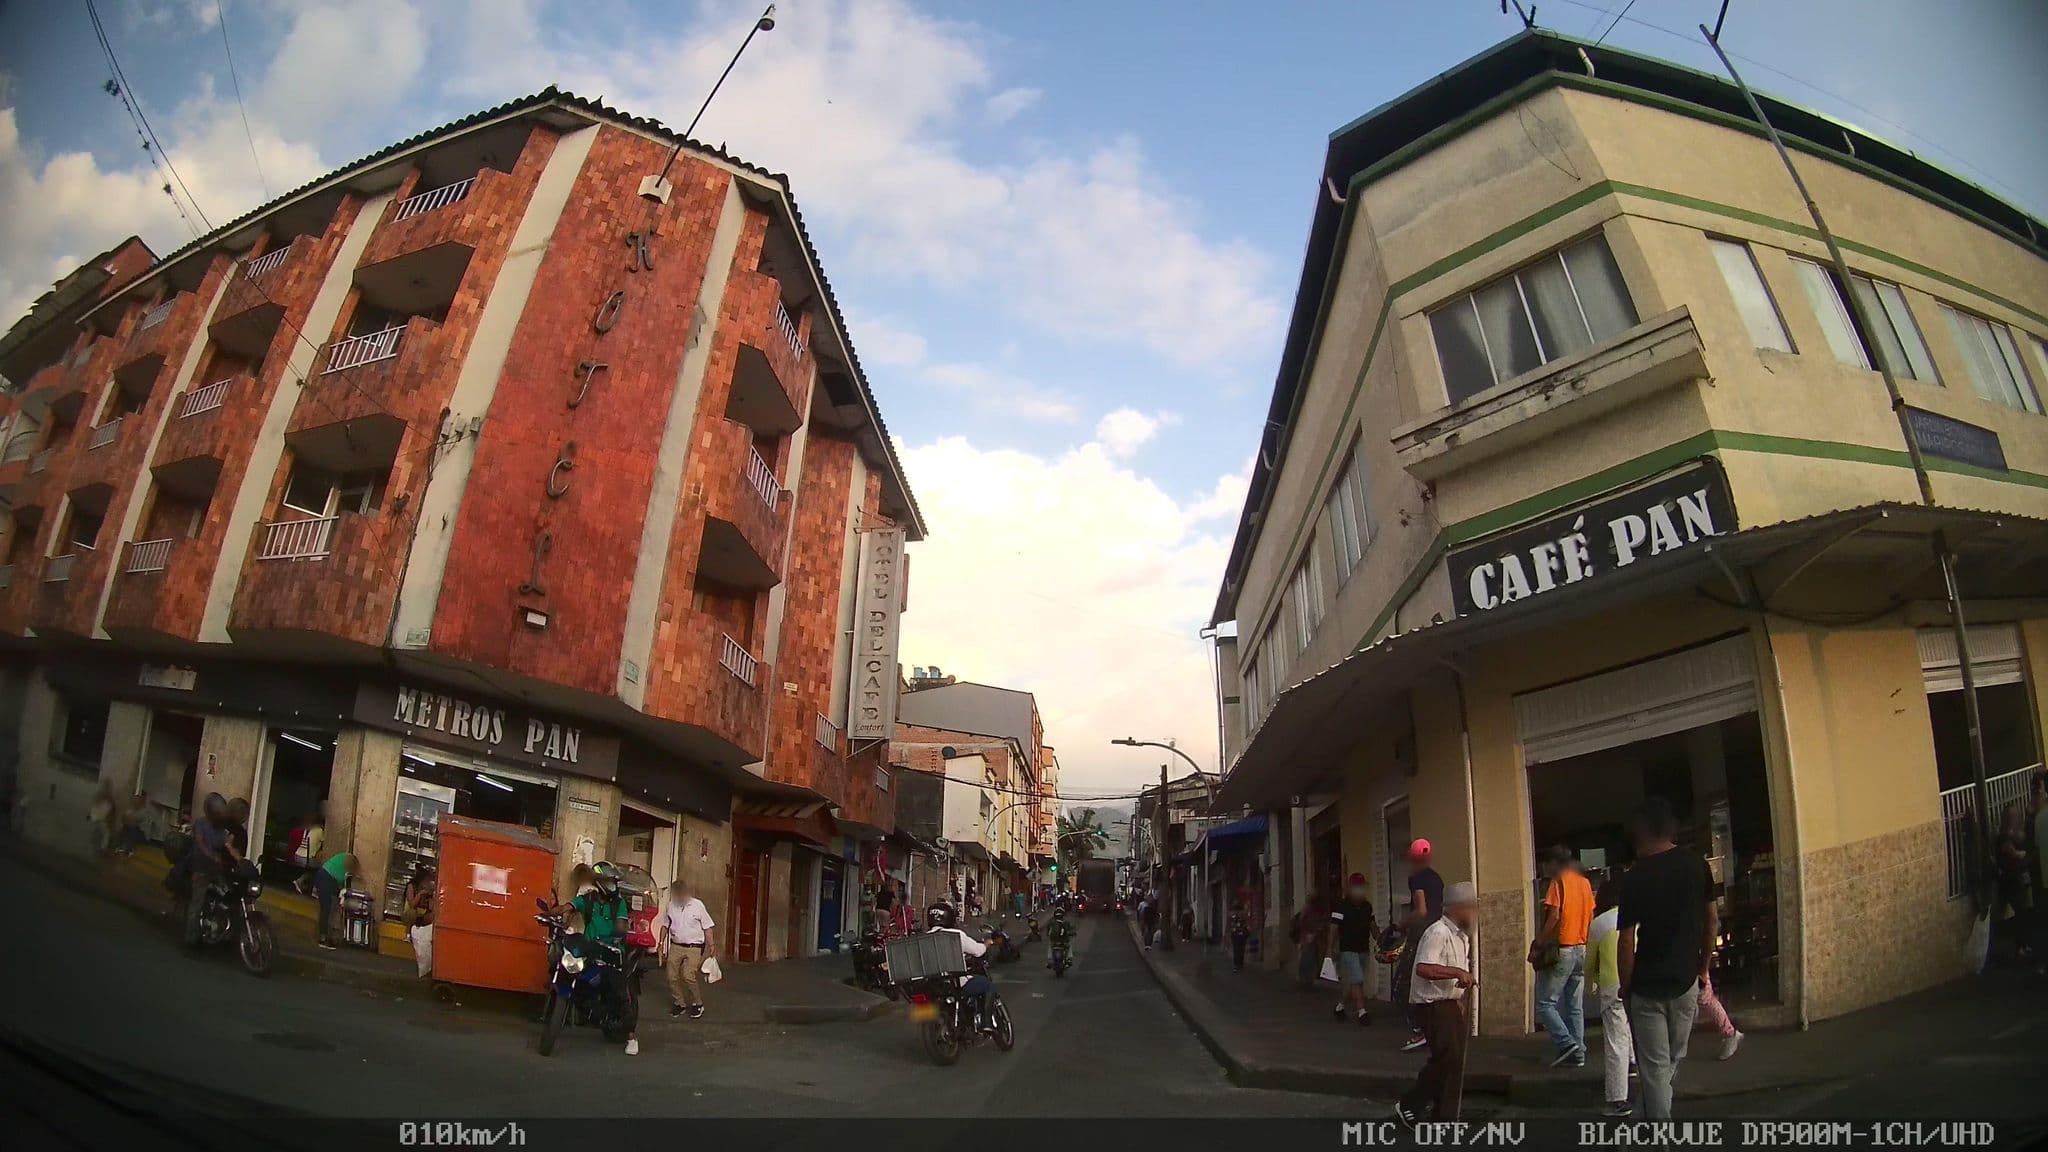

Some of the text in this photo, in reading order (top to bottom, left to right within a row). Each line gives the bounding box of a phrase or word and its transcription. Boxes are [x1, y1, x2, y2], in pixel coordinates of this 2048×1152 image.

[1468, 488, 1727, 611] CAFÉ PAN
[868, 611, 888, 652] DEL
[393, 685, 582, 763] METROS PAN
